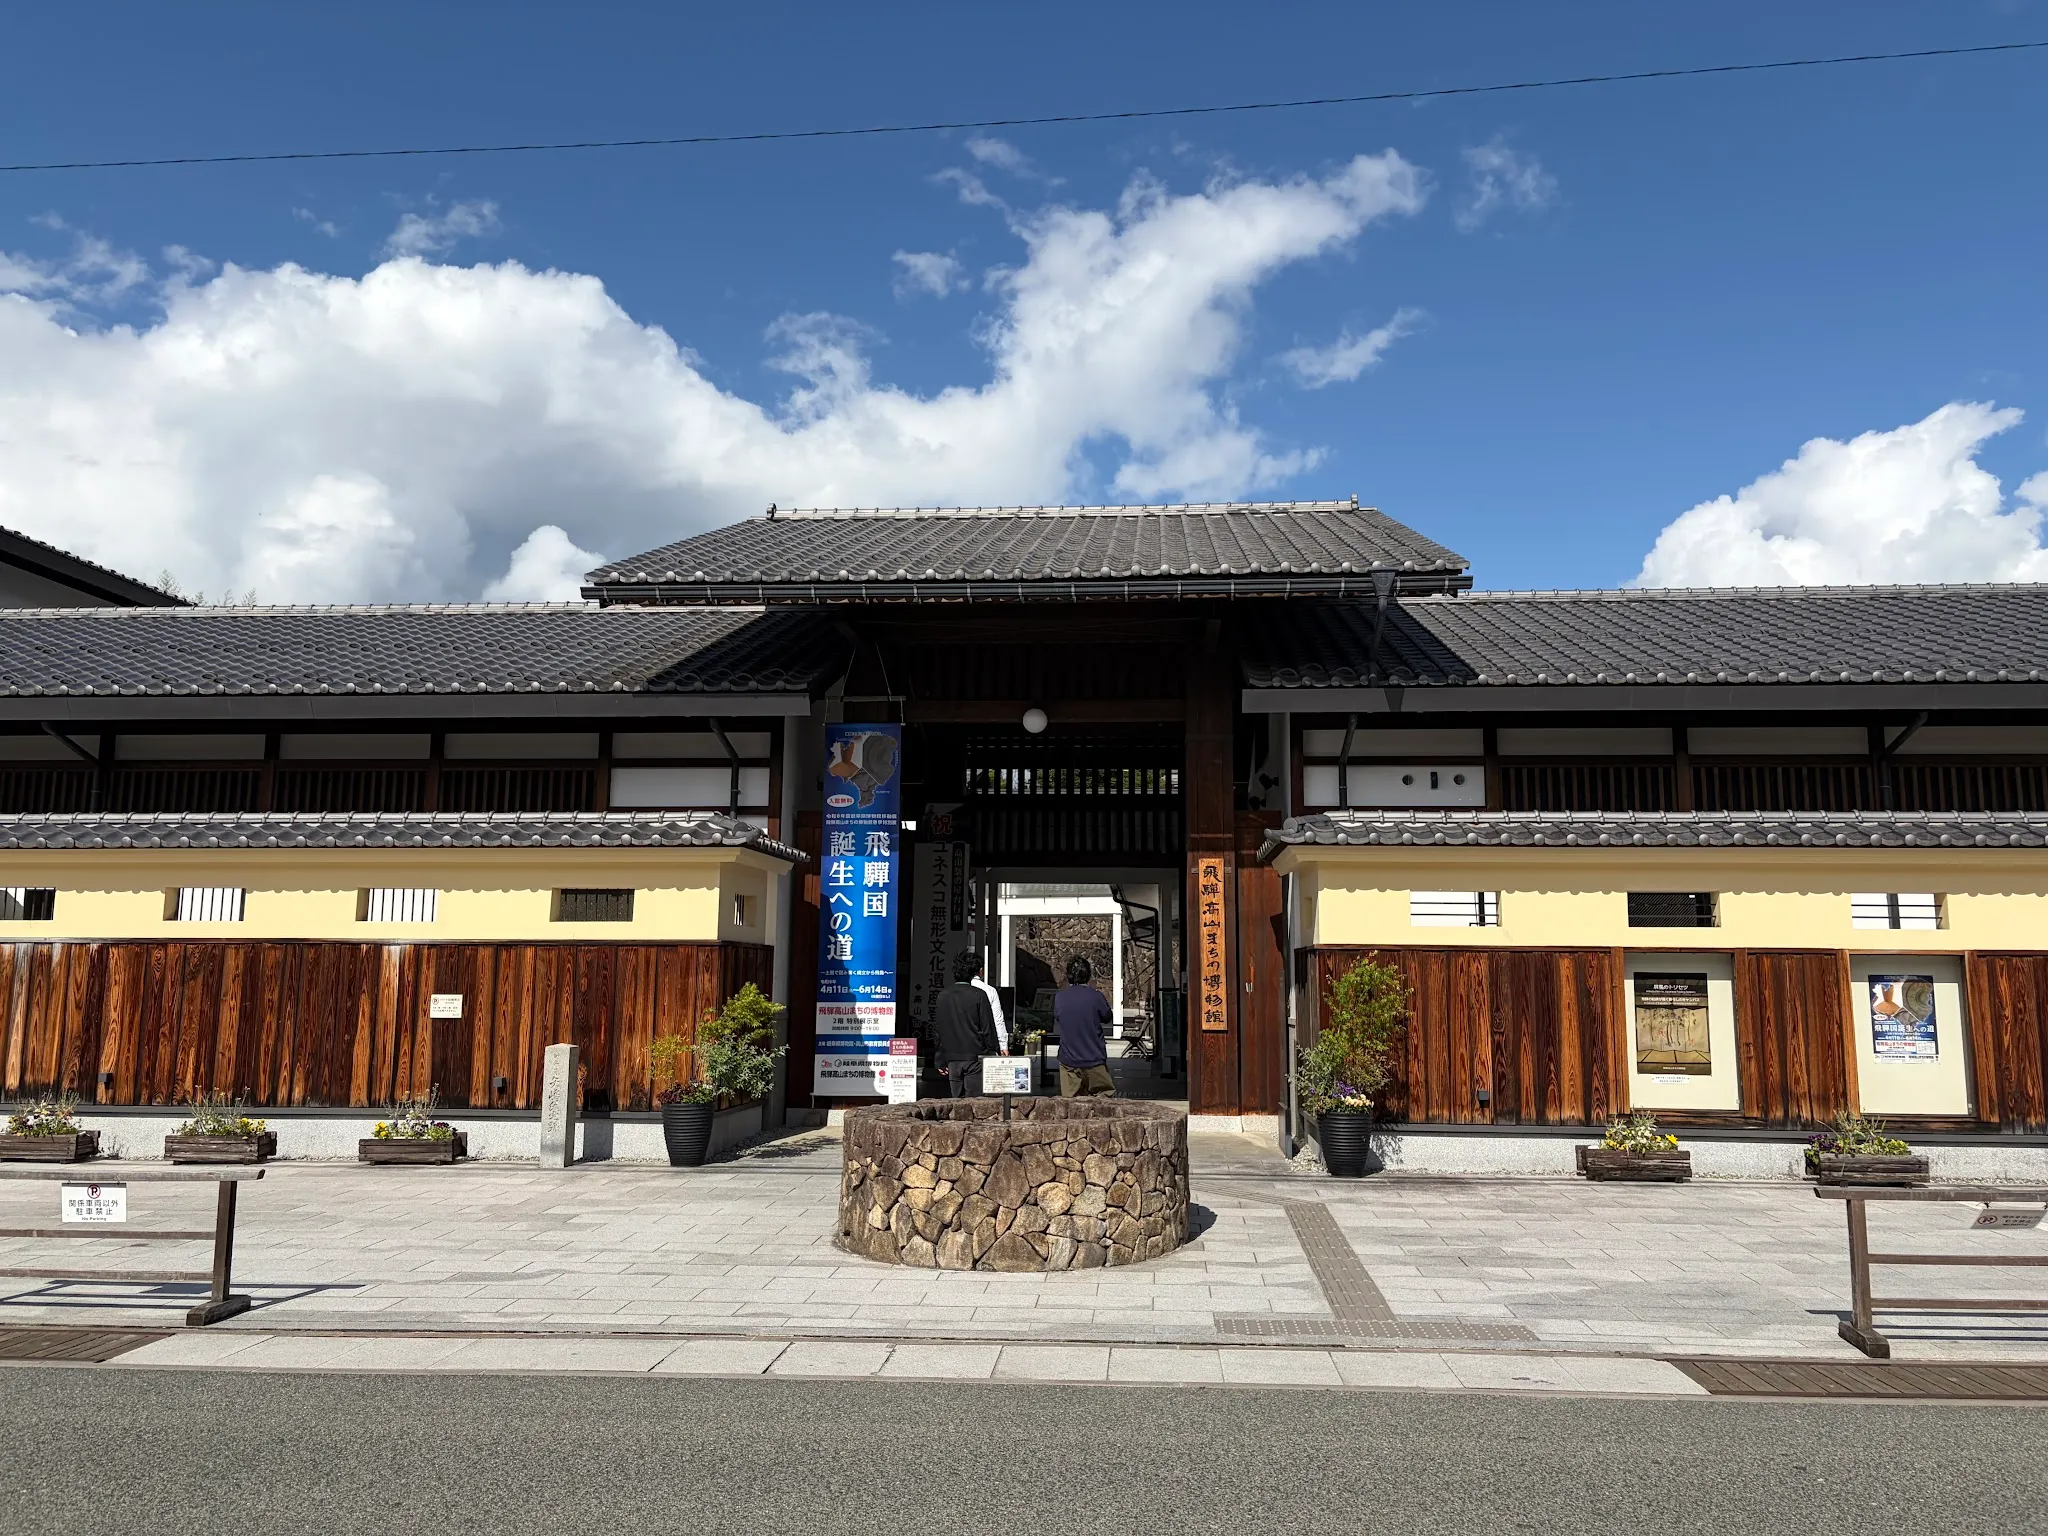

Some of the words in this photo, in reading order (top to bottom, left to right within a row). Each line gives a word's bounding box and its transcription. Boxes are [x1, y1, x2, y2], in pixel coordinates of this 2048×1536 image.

[827, 831, 856, 961] 誕生への道
[69, 1200, 118, 1208] 関係車両以外
